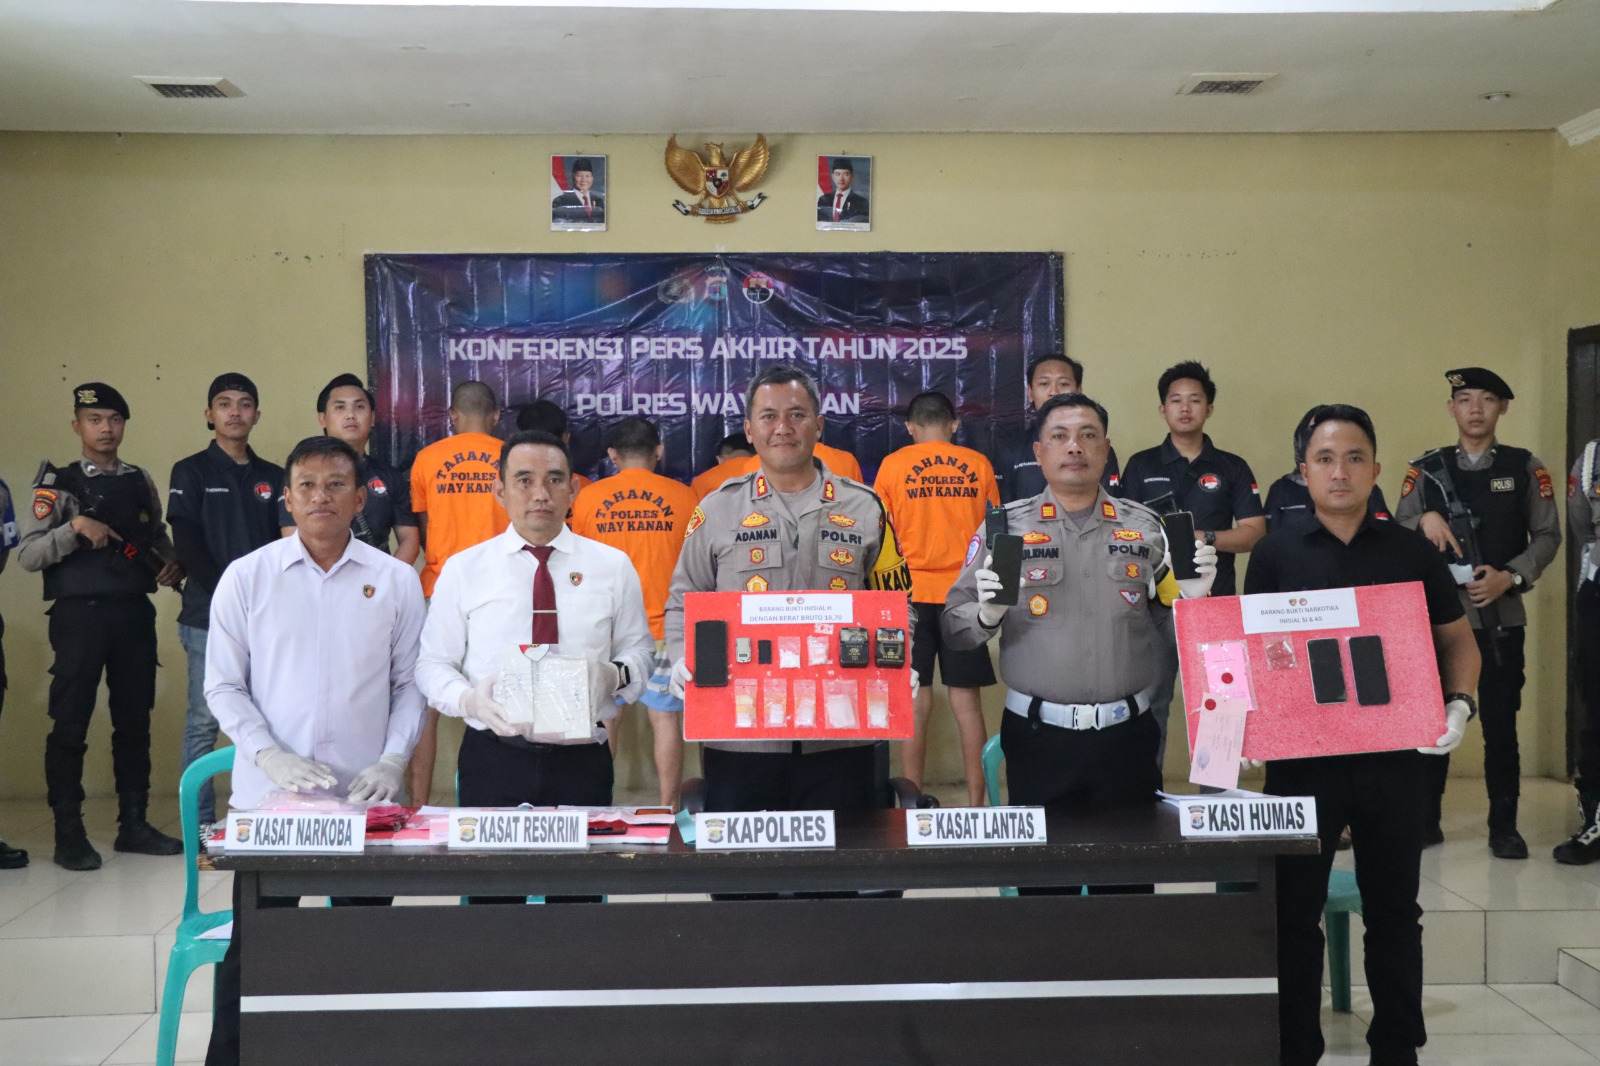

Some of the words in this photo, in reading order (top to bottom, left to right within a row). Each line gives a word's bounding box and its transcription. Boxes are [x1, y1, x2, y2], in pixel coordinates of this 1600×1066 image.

[449, 336, 624, 361] KONFERENSI
[630, 336, 703, 360] PERS
[710, 336, 803, 360] AKHIR
[804, 336, 897, 360] TAHUN
[903, 336, 968, 359] 2025
[576, 393, 688, 416] POLRES
[450, 472, 496, 481] POLRES
[905, 455, 978, 484] TAHANAN
[436, 482, 464, 494] WAY
[466, 482, 492, 493] KAN
[920, 475, 965, 485] POLRES
[907, 486, 933, 499] WAY
[935, 486, 978, 498] KANAN
[595, 489, 674, 518] TAHANAN
[610, 510, 658, 519] POLRES
[596, 521, 624, 533] WAY
[627, 520, 673, 531] KANAN
[735, 528, 777, 542] ADANAN
[821, 529, 862, 545] POLRI
[1108, 544, 1150, 559] POLRI
[936, 812, 979, 839] KASAT
[983, 811, 1034, 839] LANTAS
[1208, 803, 1245, 831] KASI
[1249, 802, 1305, 830] HUMAS
[254, 817, 294, 845] KASAT
[296, 817, 352, 846] NARKOBA
[479, 816, 520, 843] KASAT
[523, 816, 579, 843] RESKRIM
[727, 815, 826, 843] KAPOLRES
